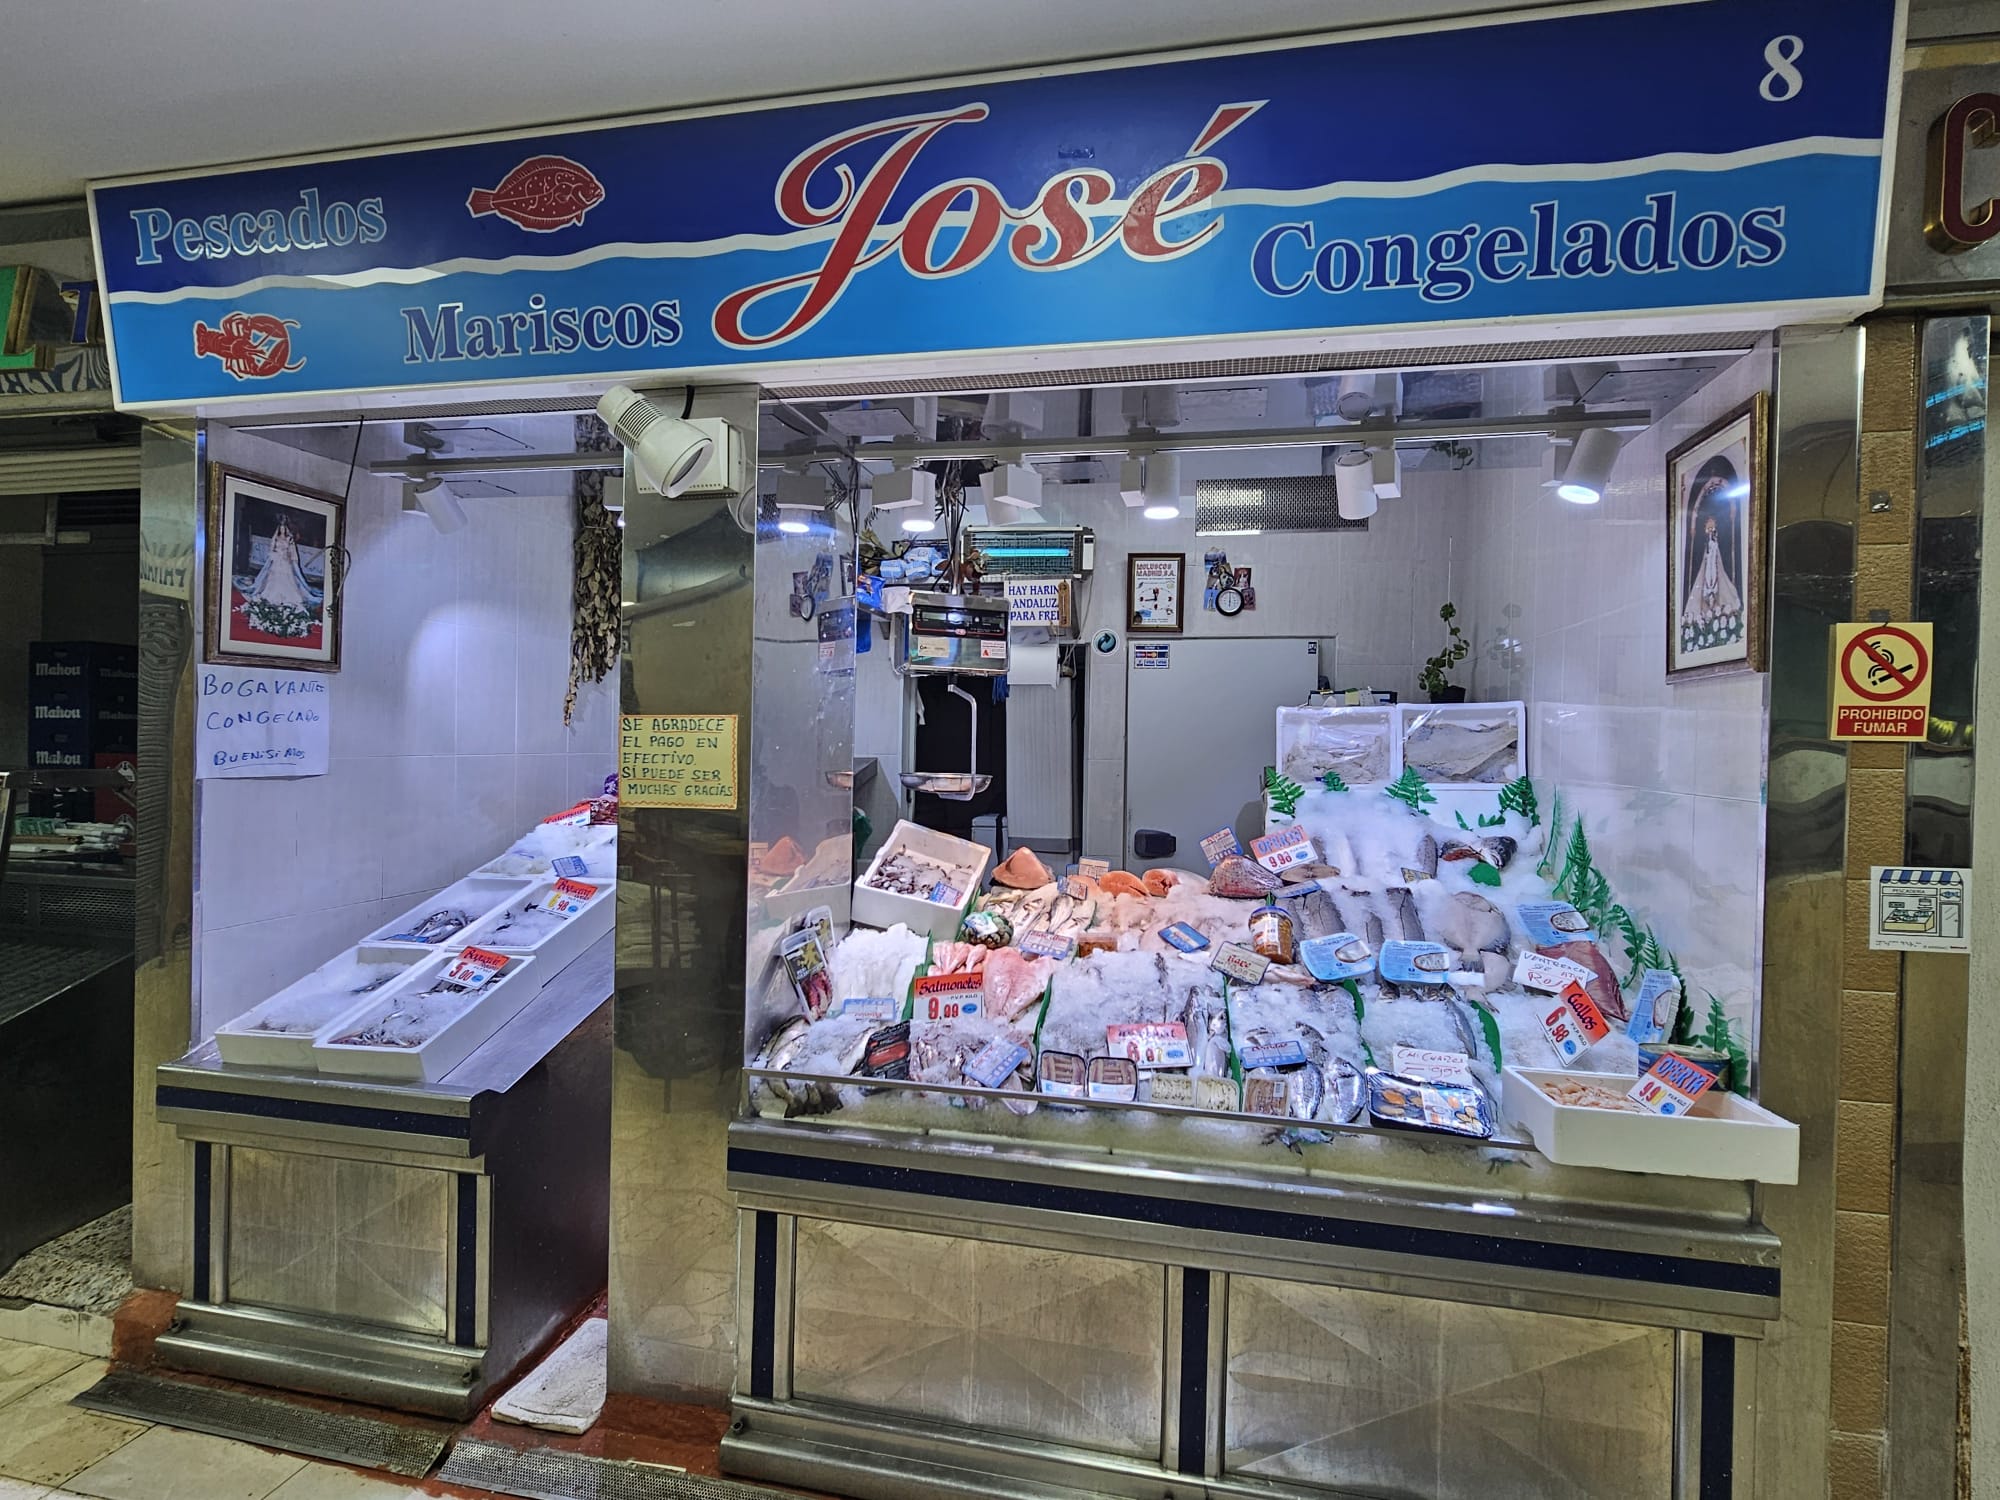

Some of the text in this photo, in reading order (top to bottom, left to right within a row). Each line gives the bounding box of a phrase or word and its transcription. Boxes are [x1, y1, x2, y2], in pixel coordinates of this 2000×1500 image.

[1758, 34, 1805, 102] 8
[130, 188, 387, 266] Pescados
[711, 99, 1271, 351] José
[1251, 190, 1788, 303] Congelados
[402, 294, 684, 365] Mariscos
[1008, 584, 1060, 596] HAY HARIN
[1012, 598, 1060, 609] ANDALUZ
[1010, 610, 1060, 621] PARA FREI
[35, 662, 81, 677] Mahou
[35, 705, 82, 720] Mahou
[1839, 708, 1924, 721] PROHIBIDO
[622, 717, 726, 732] SE AGRADECE
[1853, 721, 1908, 734] FUMAR
[622, 735, 718, 749] EL PAGO EN
[36, 750, 82, 766] Mahou
[641, 767, 686, 780] PUEDE
[690, 769, 721, 781] SER
[627, 782, 734, 797] MUCHAS GRACIAS
[1567, 993, 1598, 1030] Gallos
[1656, 1057, 1710, 1096] OFERTA
